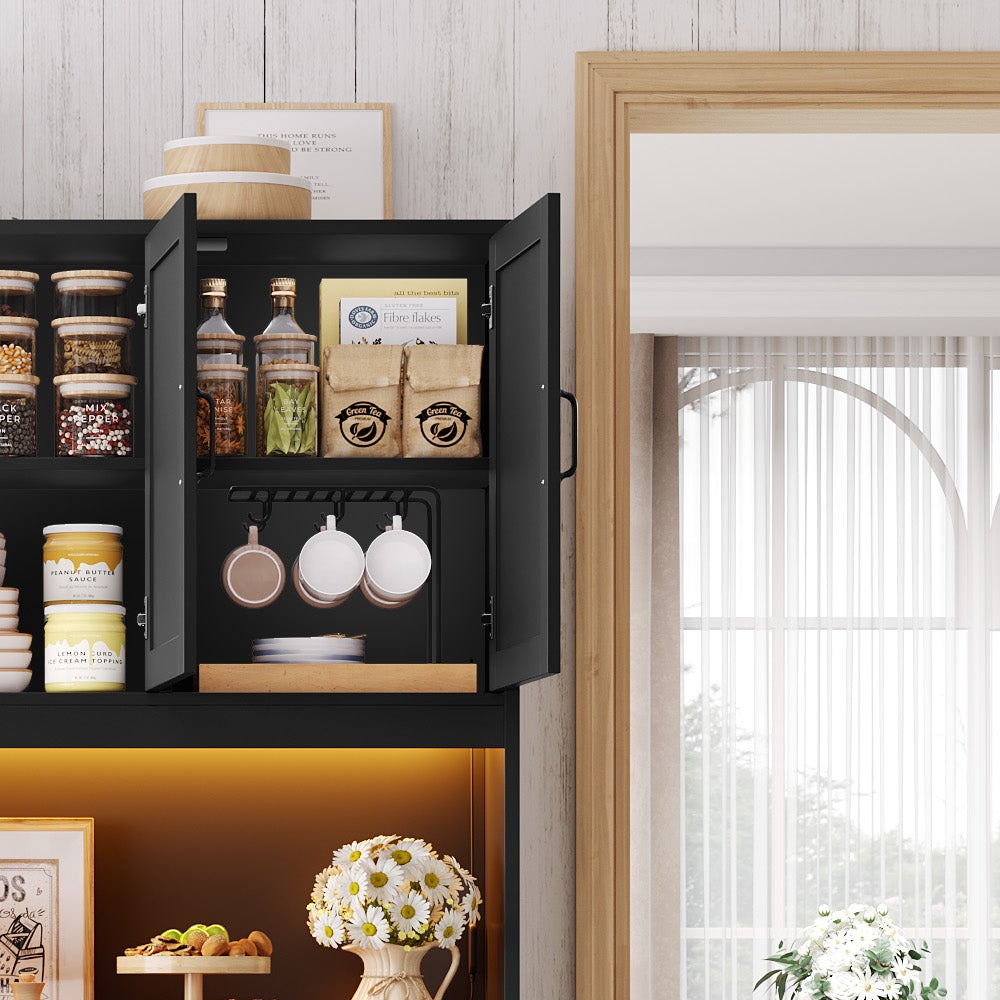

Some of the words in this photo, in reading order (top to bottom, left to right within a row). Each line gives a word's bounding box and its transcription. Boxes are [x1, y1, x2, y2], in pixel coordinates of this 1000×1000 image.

[383, 311, 410, 323] Fibre
[412, 311, 442, 323] flakes
[85, 404, 107, 412] MIX
[346, 406, 367, 416] Green
[369, 406, 383, 417] Tea
[426, 406, 448, 416] Green
[449, 406, 463, 417] Tea
